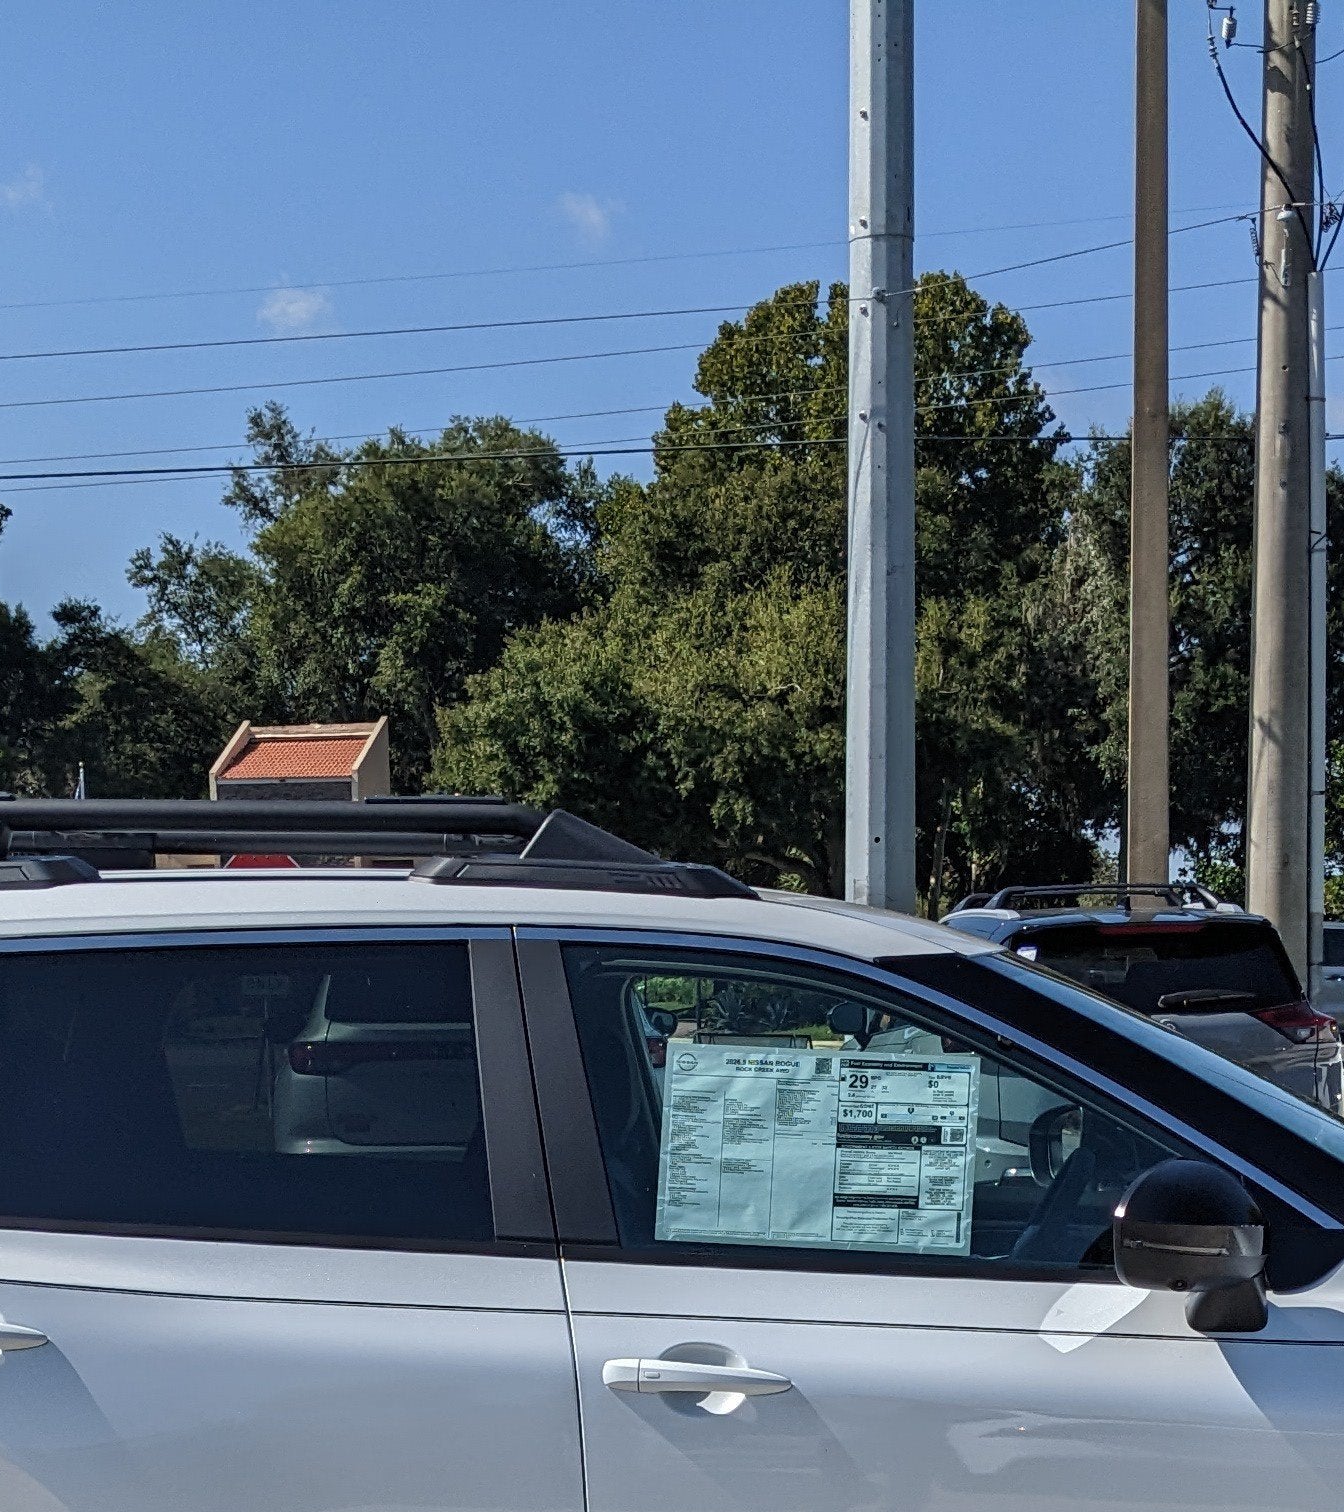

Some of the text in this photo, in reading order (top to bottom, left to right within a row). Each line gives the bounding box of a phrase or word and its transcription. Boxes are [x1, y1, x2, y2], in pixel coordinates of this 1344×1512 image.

[848, 1073, 869, 1089] 29
[927, 1080, 939, 1088] $0
[842, 1108, 873, 1119] $1,700
